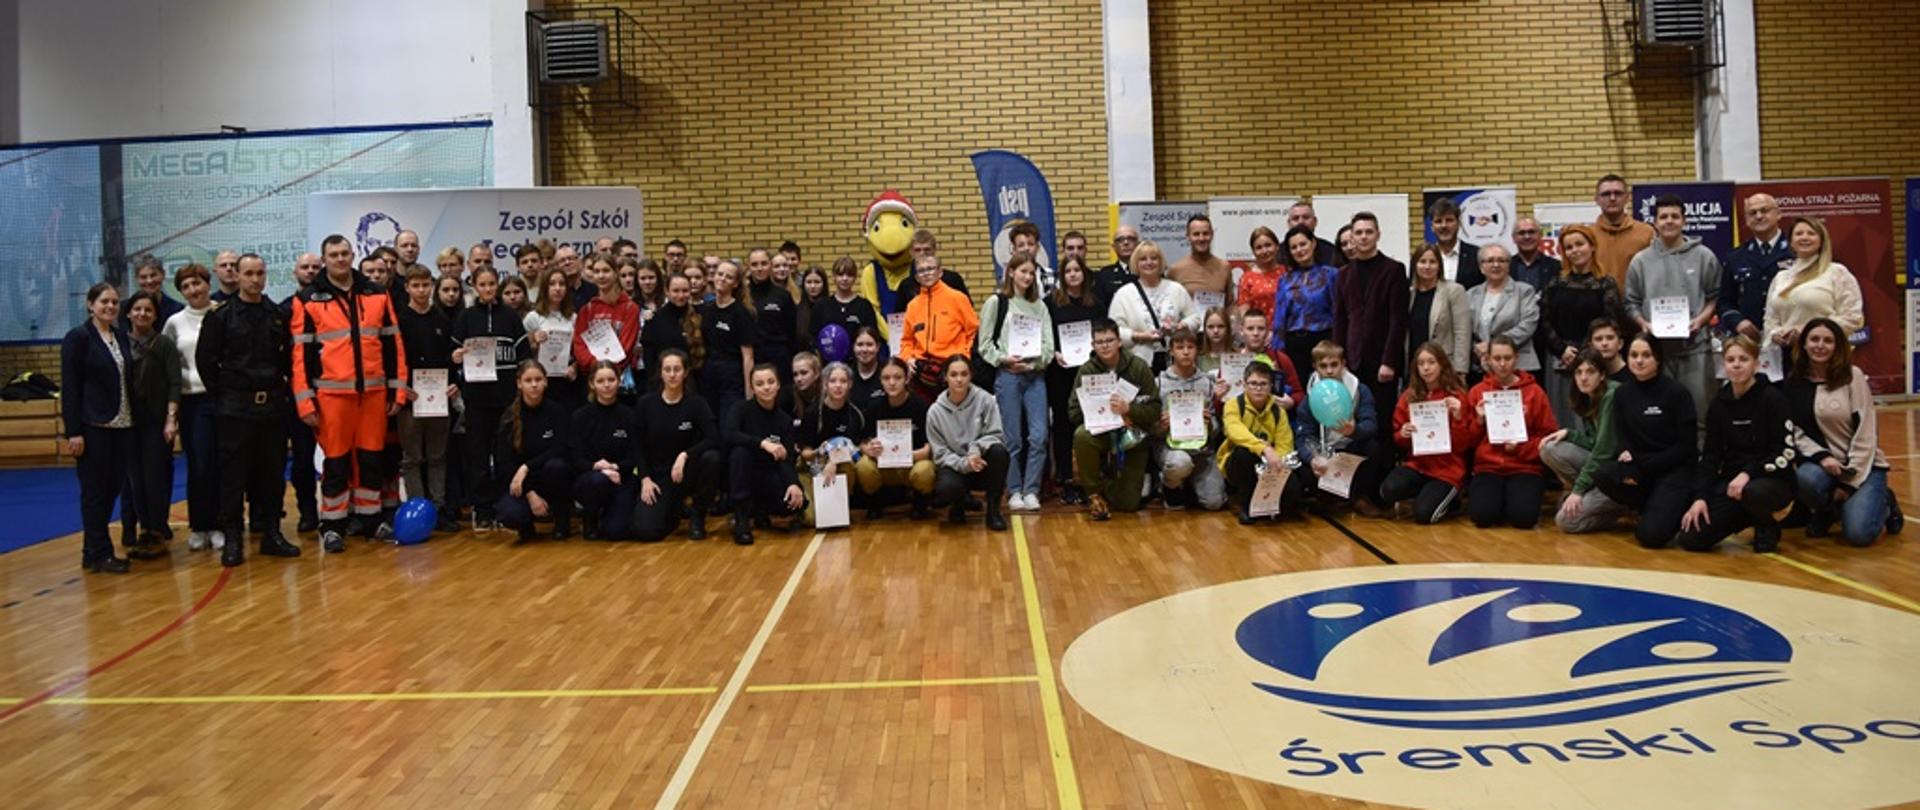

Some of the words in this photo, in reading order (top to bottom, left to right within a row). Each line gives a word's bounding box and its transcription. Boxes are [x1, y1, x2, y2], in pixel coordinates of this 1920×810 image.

[499, 207, 573, 235] Zespół
[580, 206, 629, 229] Szkół
[1280, 727, 1716, 778] Śremski
